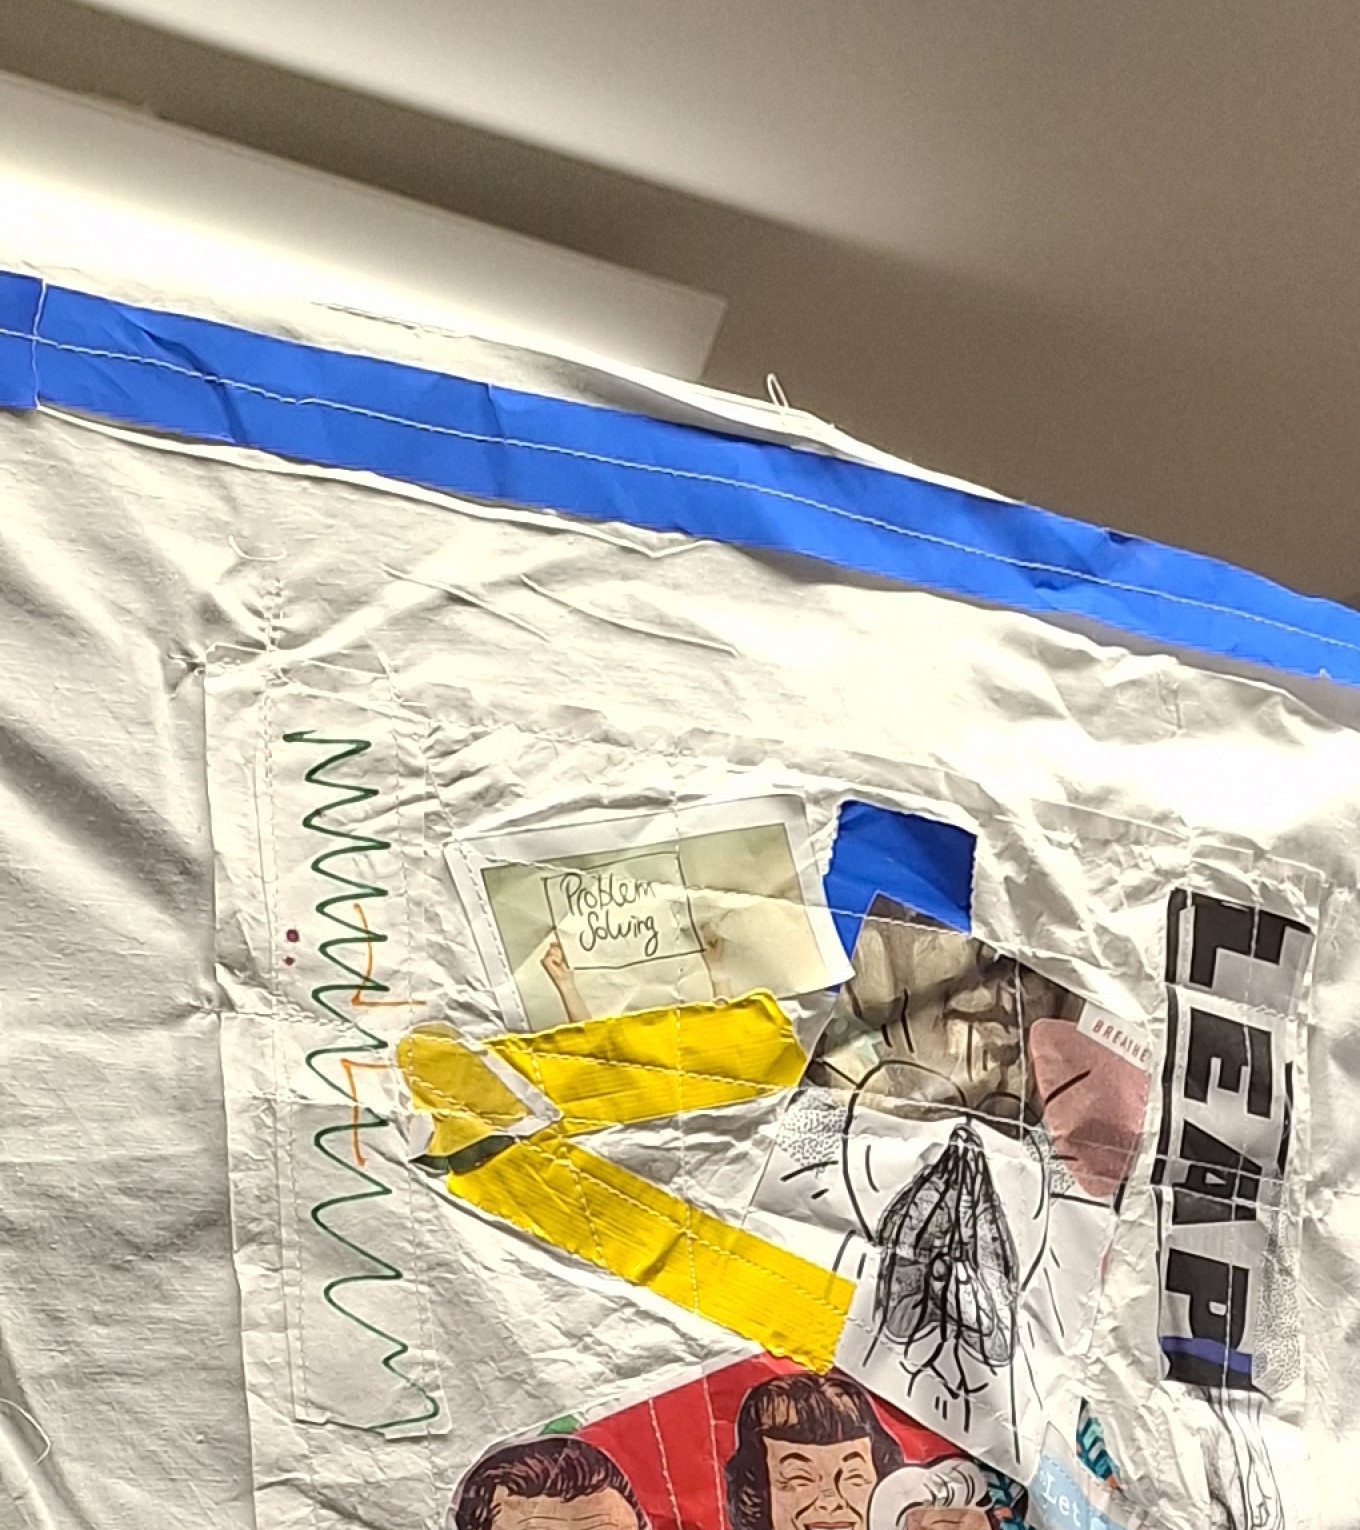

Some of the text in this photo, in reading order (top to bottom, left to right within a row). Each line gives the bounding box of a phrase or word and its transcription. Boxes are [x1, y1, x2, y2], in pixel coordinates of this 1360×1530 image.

[560, 873, 656, 916] Problem
[580, 910, 658, 957] Solving
[1091, 1020, 1152, 1062] BREATHE
[1165, 891, 1312, 1350] LEAP
